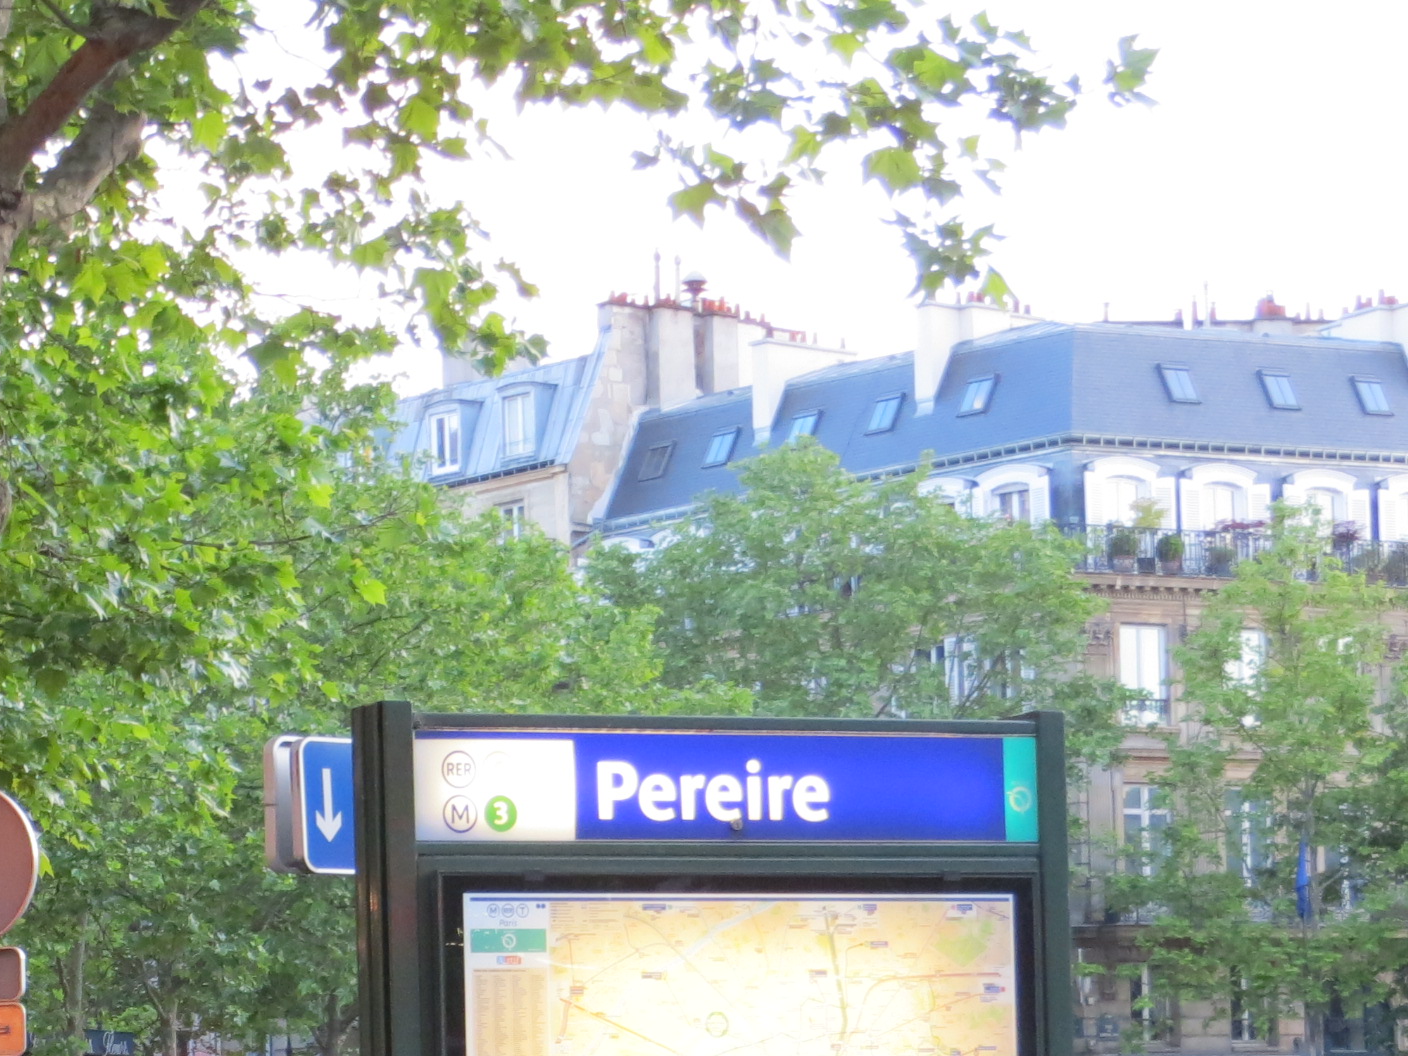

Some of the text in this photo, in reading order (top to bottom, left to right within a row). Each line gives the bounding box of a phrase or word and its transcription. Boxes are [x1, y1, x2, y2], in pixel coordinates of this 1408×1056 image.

[446, 762, 472, 777] RER
[596, 758, 831, 823] Pereire
[450, 801, 510, 826] M 3
[498, 919, 518, 927] Paris
